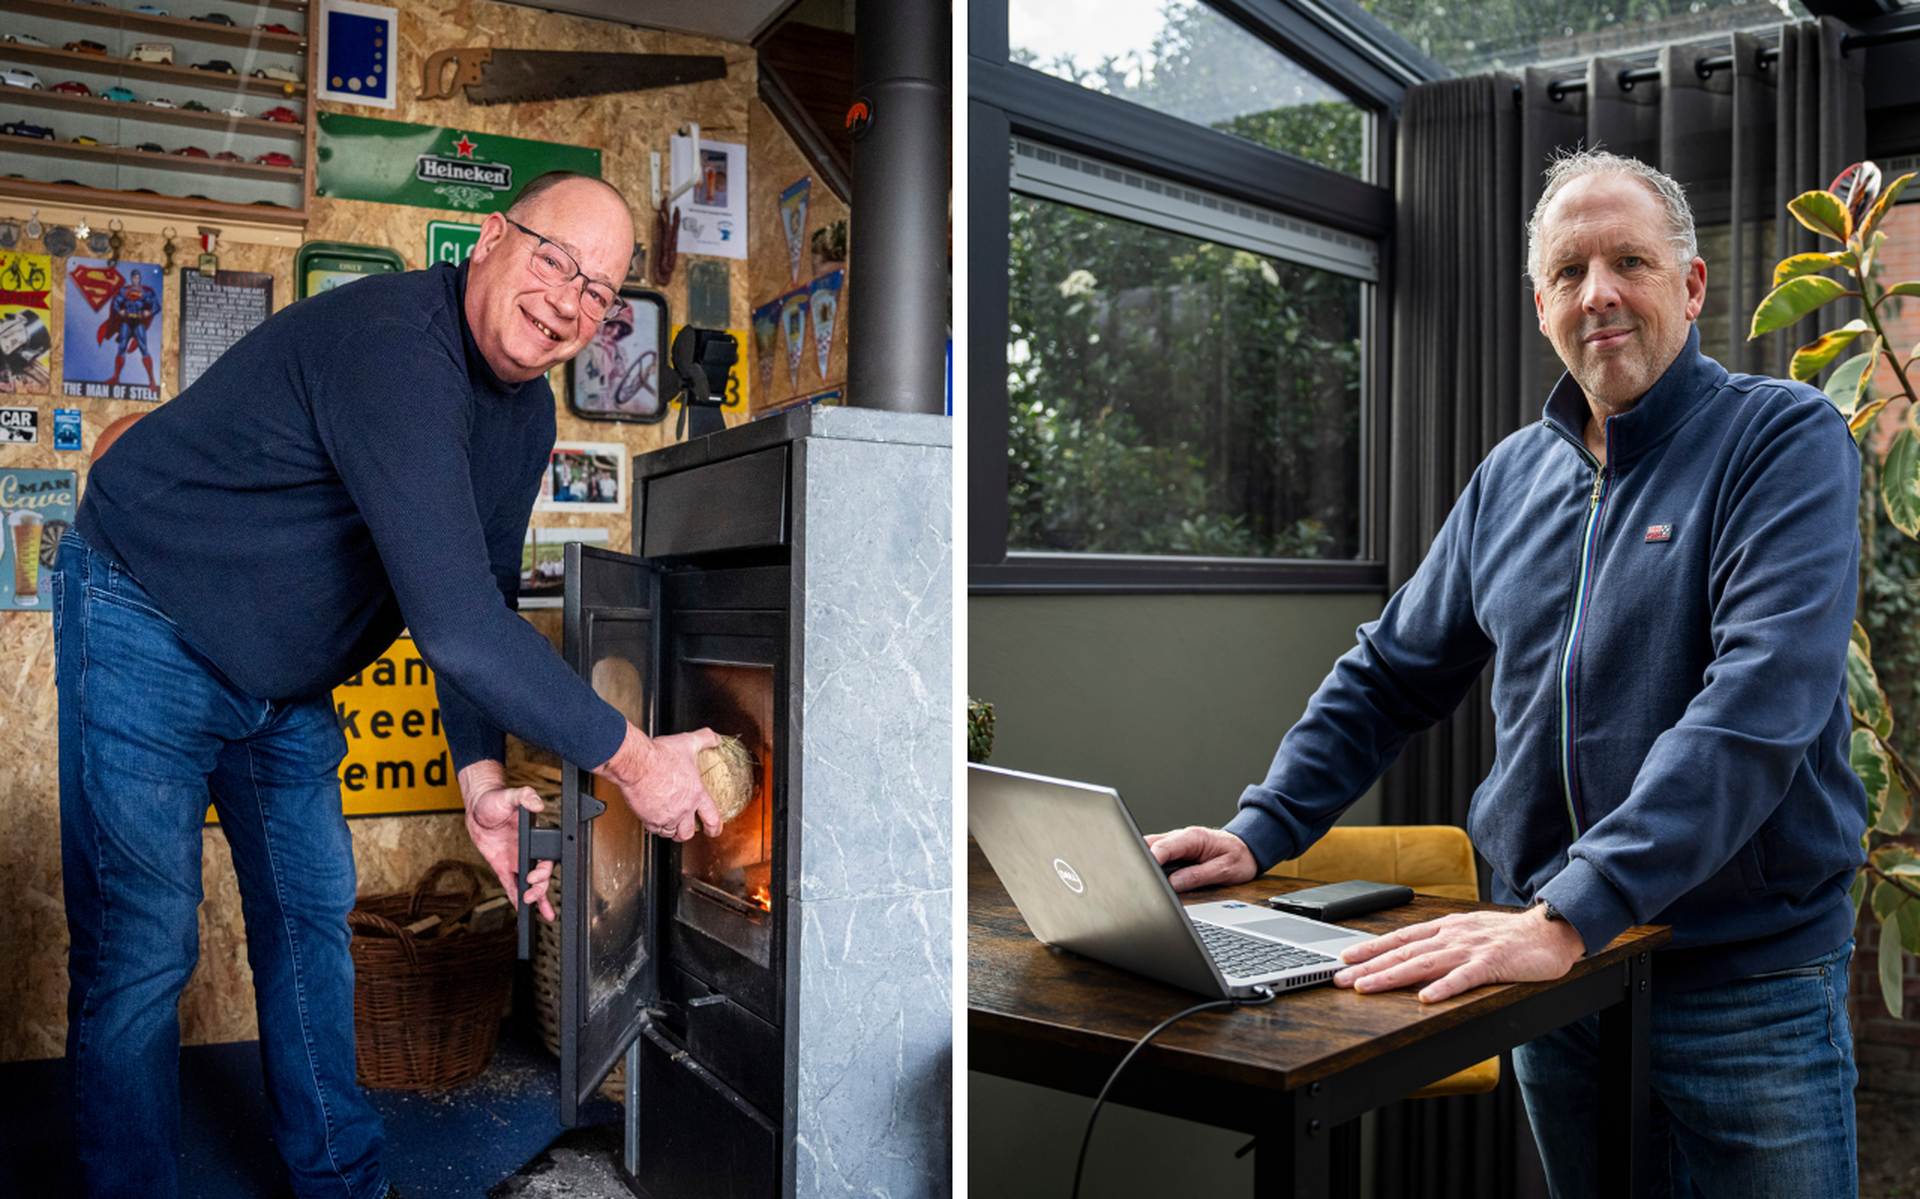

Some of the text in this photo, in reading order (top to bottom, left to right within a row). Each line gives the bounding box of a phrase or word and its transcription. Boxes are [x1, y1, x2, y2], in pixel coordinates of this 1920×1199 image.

[424, 160, 505, 185] Heineken
[63, 382, 83, 396] THE
[85, 383, 110, 397] MAN
[113, 385, 127, 399] OF
[0, 410, 32, 427] CAR
[0, 474, 72, 509] Cave
[18, 479, 71, 494] MAN
